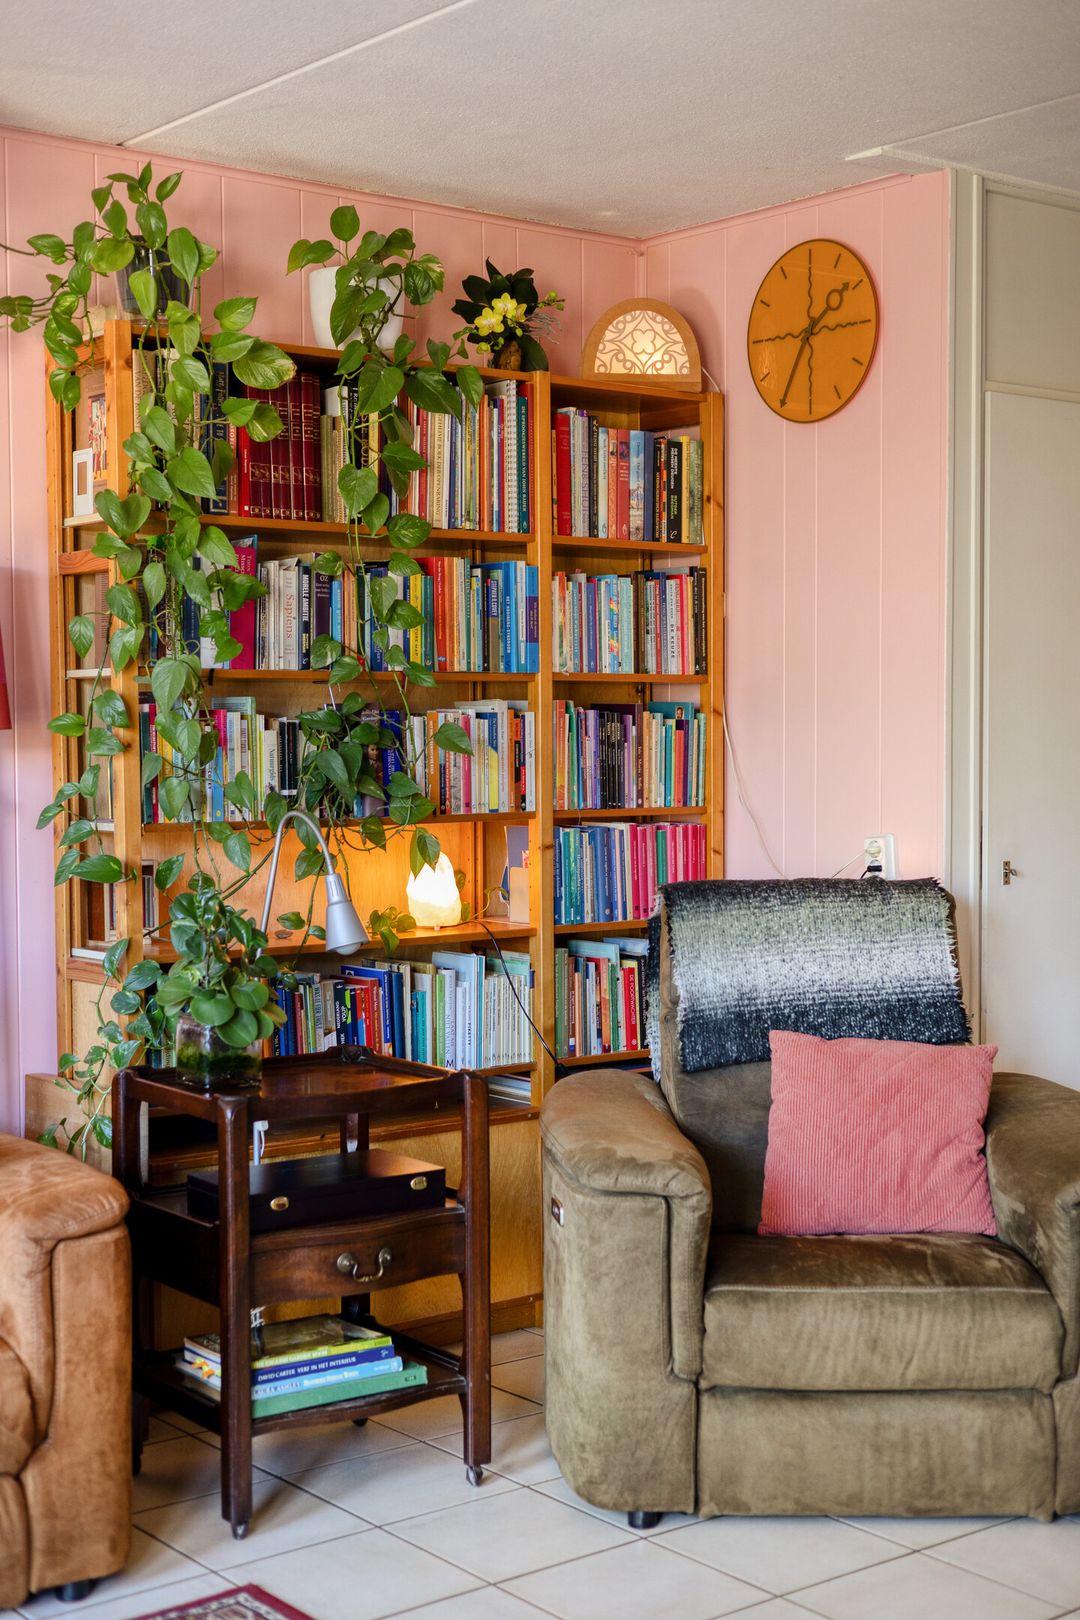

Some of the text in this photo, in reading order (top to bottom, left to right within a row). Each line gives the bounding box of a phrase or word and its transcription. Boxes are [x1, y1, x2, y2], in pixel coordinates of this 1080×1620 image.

[521, 405, 527, 413] DE
[285, 594, 296, 640] Sapiens
[257, 1371, 275, 1382] DAVID
[276, 1369, 295, 1378] CARTER
[297, 1366, 309, 1374] VERF
[318, 1361, 329, 1369] HET
[329, 1356, 357, 1367] INTERIEUR
